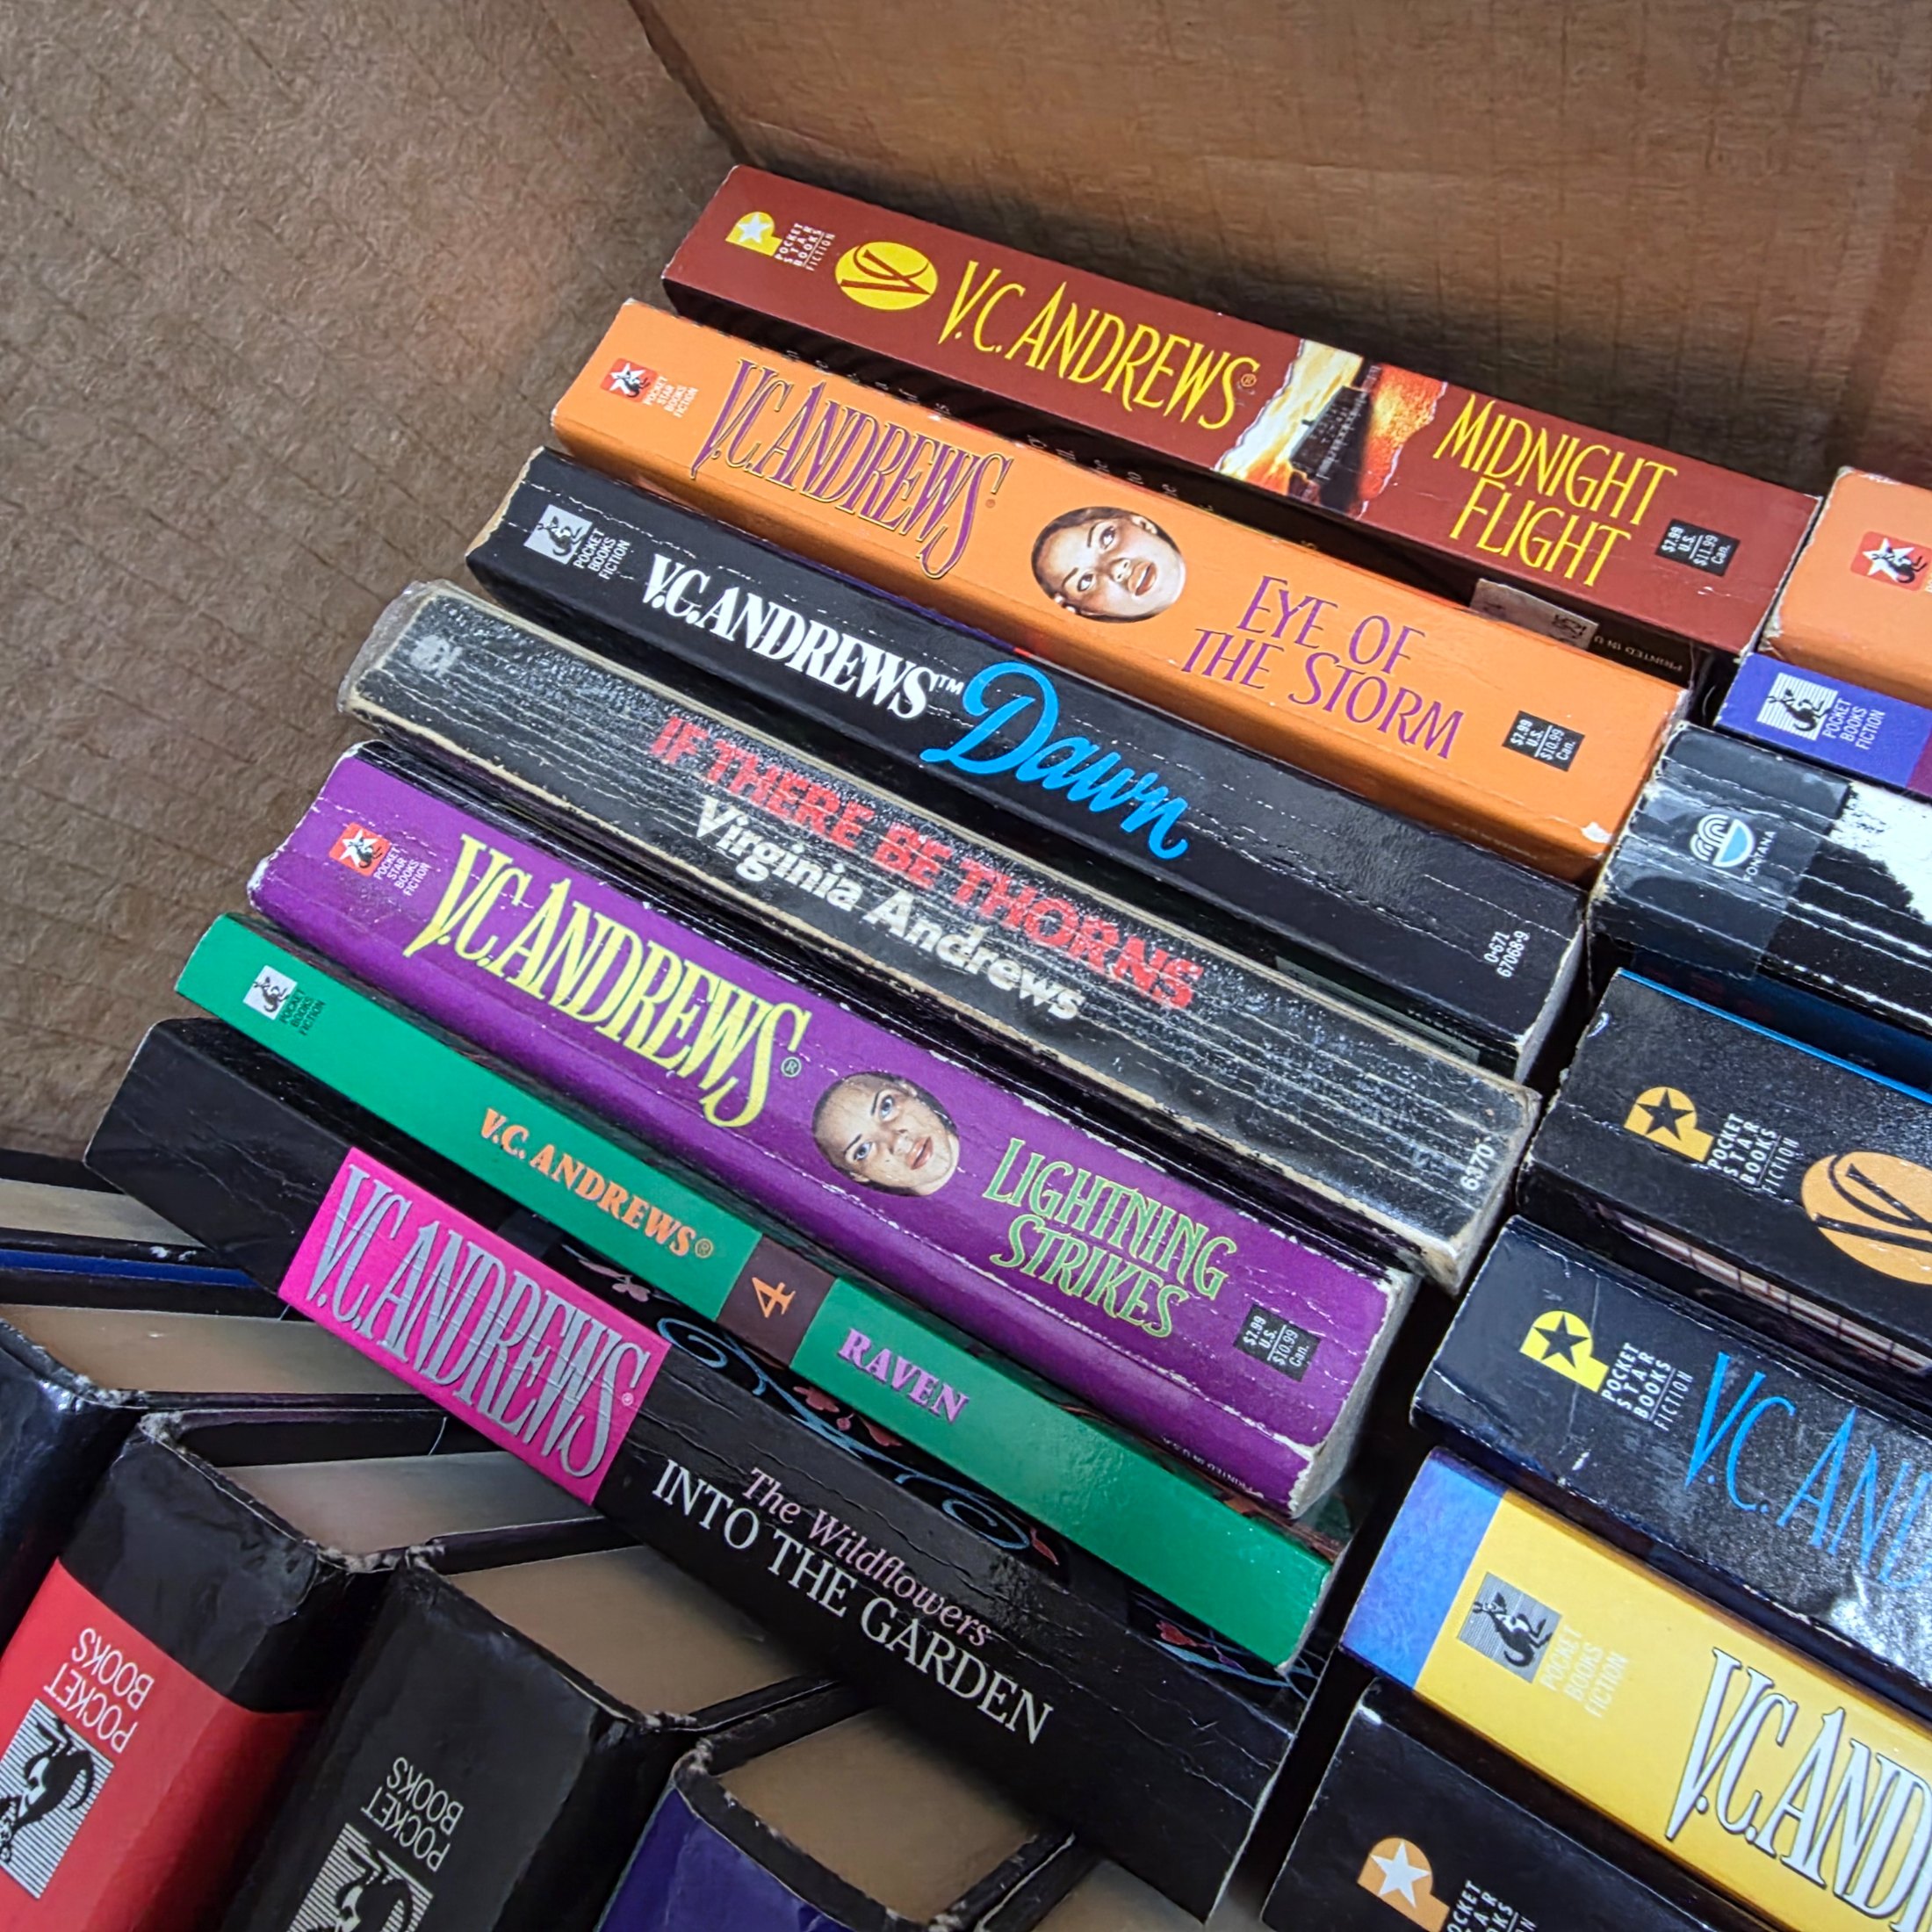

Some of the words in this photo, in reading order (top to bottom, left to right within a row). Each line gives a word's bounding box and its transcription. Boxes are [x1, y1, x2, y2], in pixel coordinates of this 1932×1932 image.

[775, 223, 803, 261] POCKET
[783, 226, 816, 263] STAR
[793, 229, 824, 267] BOOKS
[805, 233, 835, 271] FICTION
[1433, 393, 1677, 525] MIDNIGHT
[573, 528, 605, 569] POCKET
[588, 537, 616, 572] BOOKS
[1450, 477, 1631, 587] FLIGHT
[1661, 526, 1684, 552] $7.99
[1693, 534, 1719, 566] $11.99
[598, 539, 631, 580] FICTION
[1236, 575, 1339, 649] EYE
[1348, 615, 1426, 674] OF
[1180, 628, 1285, 689] THE
[1287, 652, 1465, 760] STORM
[1510, 718, 1533, 746] $7.99
[1822, 697, 1852, 739] POCKET
[1840, 705, 1868, 744] BOOKS
[1855, 710, 1886, 751] FICTION
[919, 660, 1189, 859] Dawn
[1539, 728, 1565, 761] $10.99
[1555, 741, 1576, 761] Can.
[373, 847, 401, 881] POCKET
[386, 857, 407, 881] STAR
[394, 859, 421, 889] BOOKS
[403, 862, 431, 897] FICTION
[649, 716, 710, 766] IF
[705, 739, 876, 850] THERE
[874, 822, 954, 890] BE
[951, 857, 1204, 1010] THORNS
[696, 795, 863, 913] Virginia
[863, 889, 1086, 1020] Andrews
[279, 988, 306, 1025] POCKET
[290, 996, 315, 1028] BOOKS
[299, 998, 327, 1037] FICTION
[480, 1107, 530, 1160] V.C.
[1707, 1114, 1745, 1171] POCKET
[1723, 1121, 1761, 1177] STAR
[1740, 1128, 1778, 1186] BOOKS
[1762, 1137, 1800, 1195] FICTION
[982, 1137, 1237, 1301] LIGHTNING
[752, 1276, 797, 1319] 4
[989, 1214, 1189, 1338] STRIKES
[1243, 1316, 1266, 1346] $7.99
[1272, 1329, 1299, 1366] $10.99
[837, 1327, 970, 1425] RAVEN
[1288, 1345, 1310, 1367] Can.
[1601, 1343, 1640, 1403] POCKET
[1617, 1352, 1655, 1410] STAR
[1633, 1359, 1672, 1420] BOOKS
[1654, 1370, 1694, 1432] FICTION
[741, 1467, 802, 1525] The
[807, 1509, 992, 1647] Wildflowers
[652, 1459, 761, 1551] INTO
[768, 1530, 858, 1618] THE
[860, 1597, 1054, 1746] GARDEN
[71, 1627, 155, 1712] BOOKS
[43, 1662, 139, 1754] POCKET
[386, 1756, 465, 1836] BOOKS
[360, 1785, 451, 1873] POCKET
[1446, 1880, 1481, 1932] OCKET
